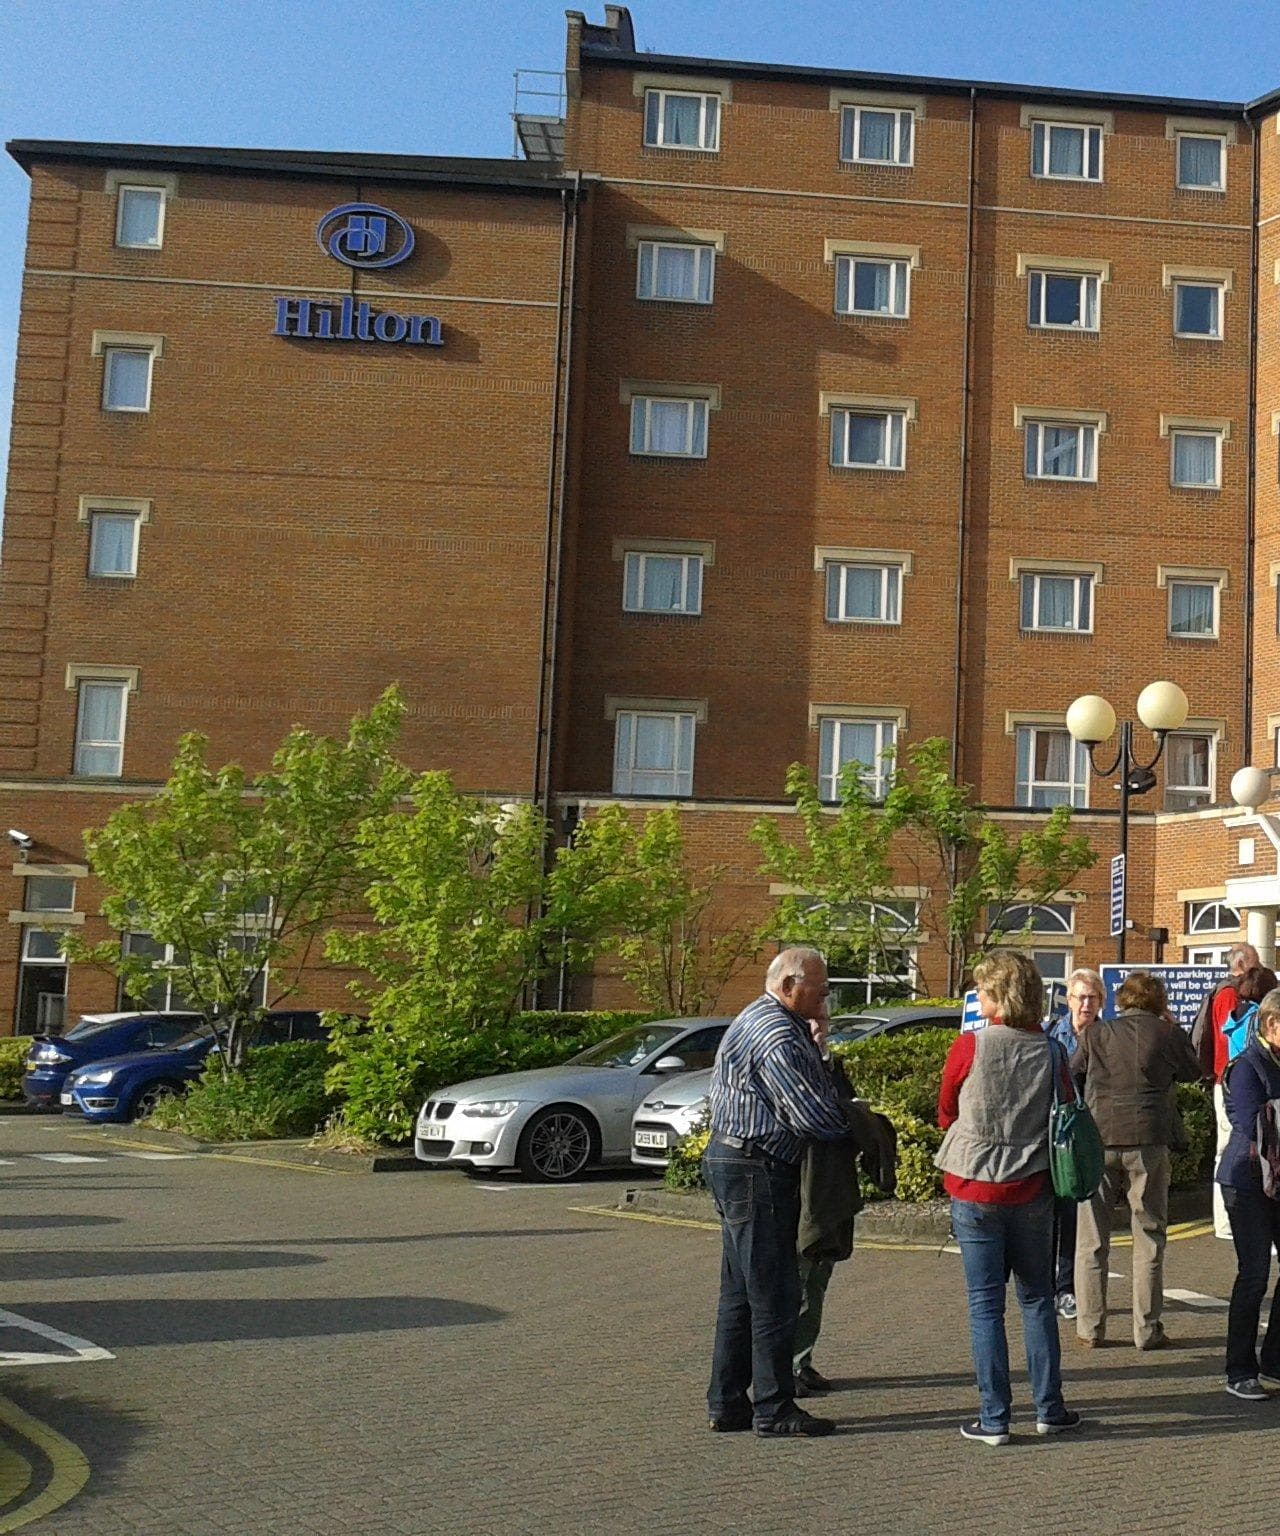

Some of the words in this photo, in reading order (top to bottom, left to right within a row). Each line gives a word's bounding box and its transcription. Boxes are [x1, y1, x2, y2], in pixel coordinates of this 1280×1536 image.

[271, 296, 444, 345] Hilton
[1177, 970, 1213, 980] parking
[1171, 981, 1187, 989] will
[1189, 981, 1201, 989] be
[1184, 993, 1202, 1002] you
